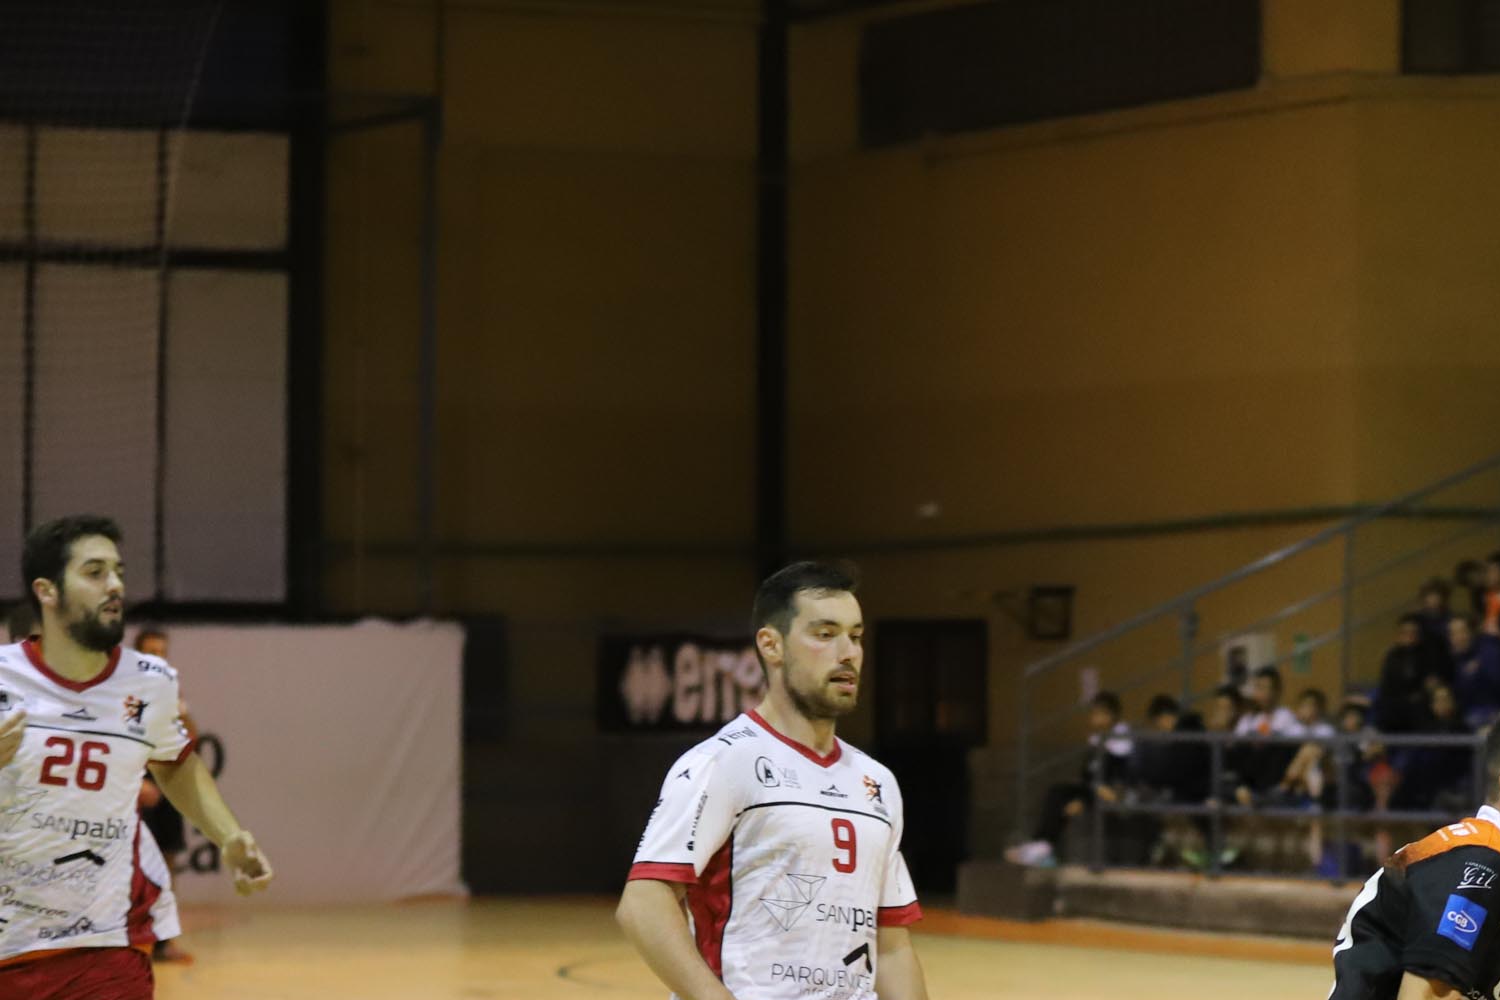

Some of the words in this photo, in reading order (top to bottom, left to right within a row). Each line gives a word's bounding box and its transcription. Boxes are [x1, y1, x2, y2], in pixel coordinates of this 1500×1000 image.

[40, 736, 111, 791] 26
[831, 818, 857, 874] 9
[1459, 866, 1497, 889] Gil
